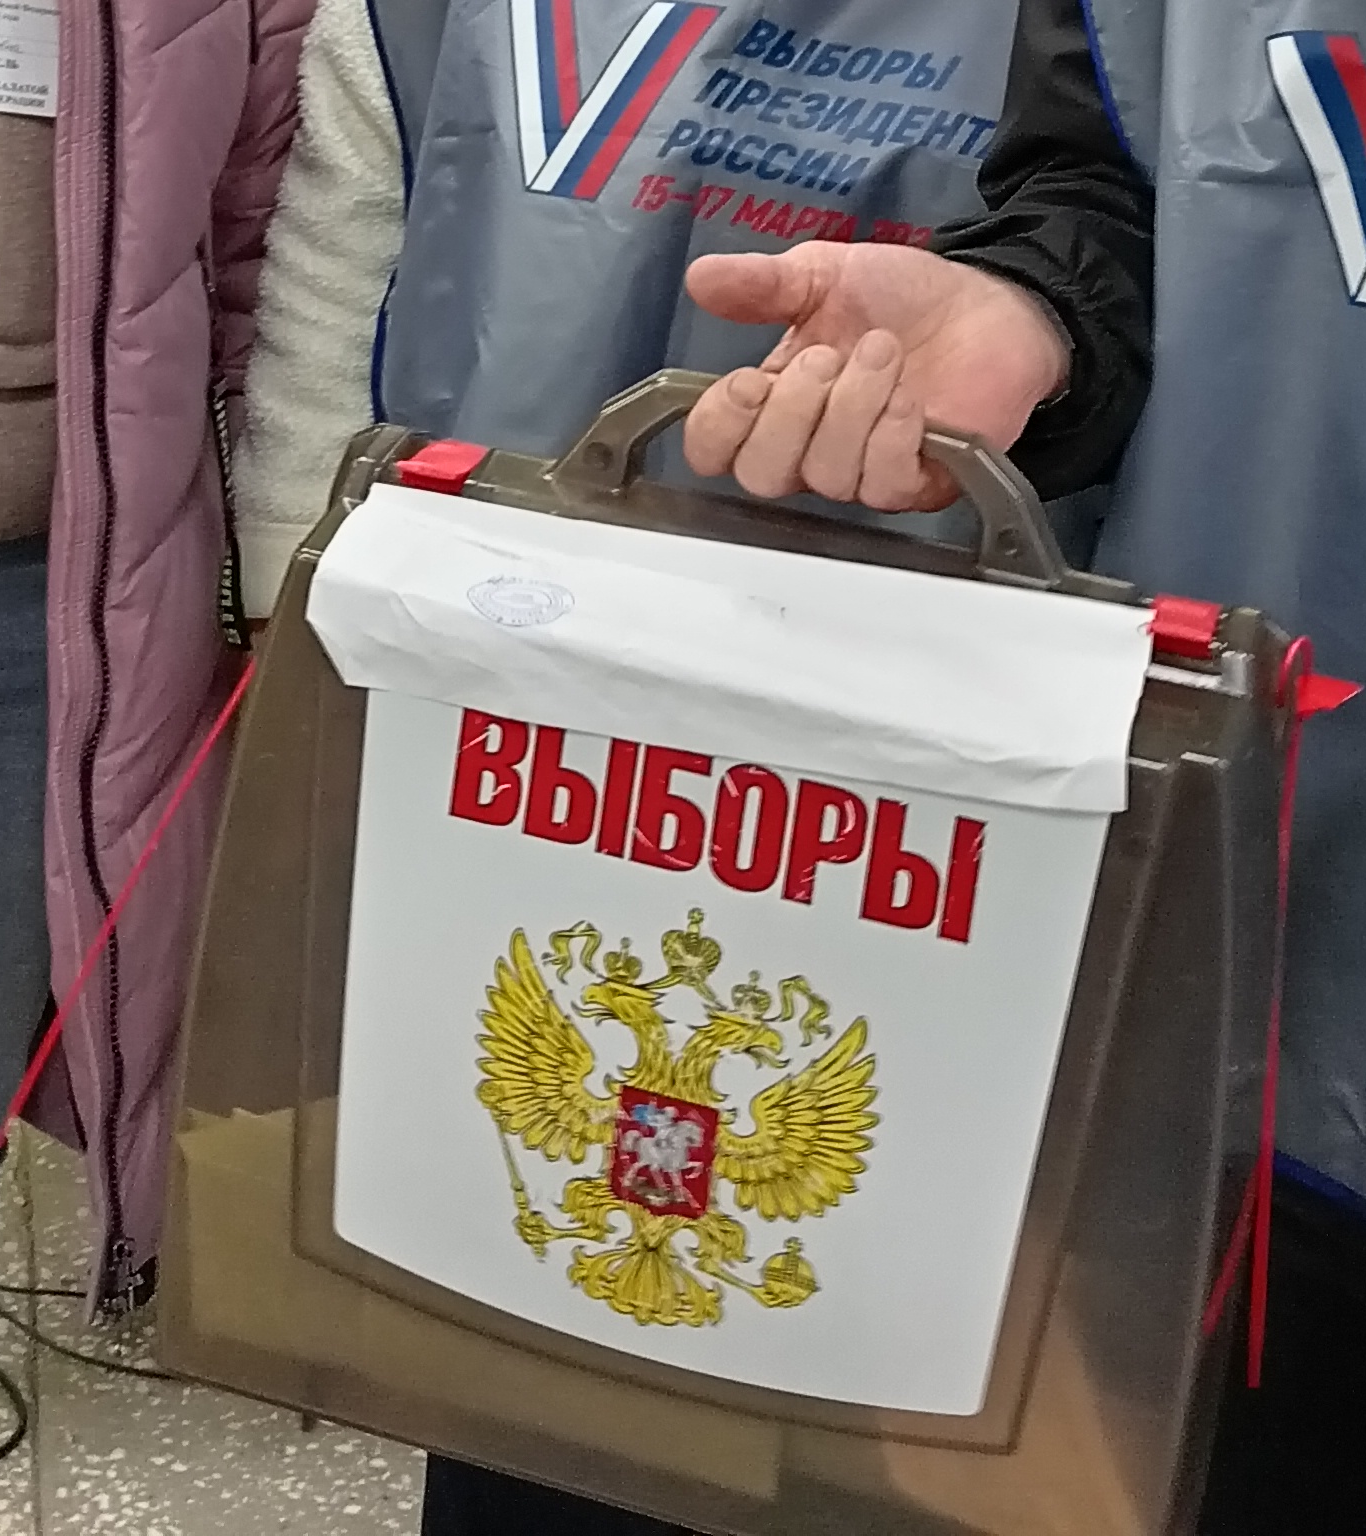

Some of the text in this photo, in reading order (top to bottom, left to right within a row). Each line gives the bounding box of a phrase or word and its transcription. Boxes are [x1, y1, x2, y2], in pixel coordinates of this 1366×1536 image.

[735, 18, 962, 92] ВЫБОРЫ
[694, 66, 998, 161] ПРЕЗИДЕНТ
[656, 118, 870, 196] РОССИИ
[730, 193, 859, 243] МАРТА
[289, 359, 304, 381] 6
[448, 707, 989, 945] ВЫБОРЫ
